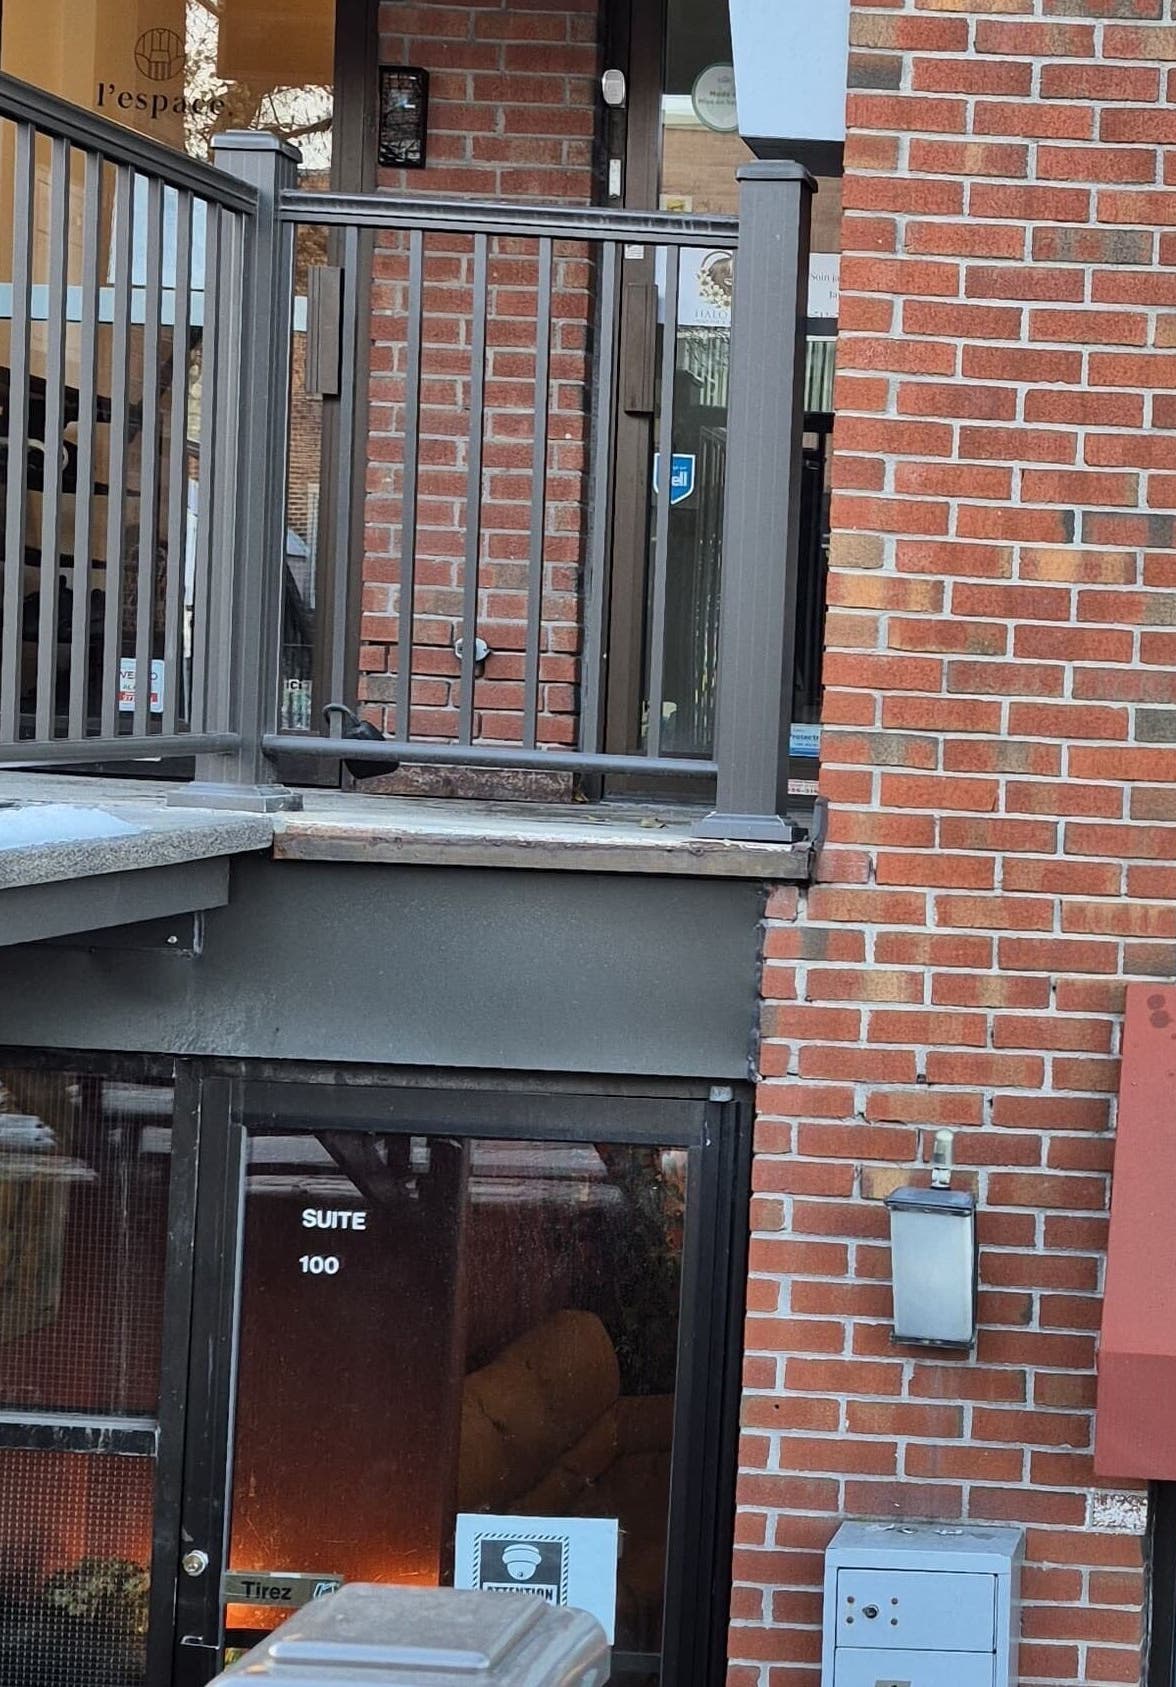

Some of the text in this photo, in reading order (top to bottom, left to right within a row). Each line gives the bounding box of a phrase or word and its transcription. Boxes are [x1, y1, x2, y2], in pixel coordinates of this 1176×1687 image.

[302, 1208, 367, 1230] SUITE
[298, 1255, 340, 1275] 100
[241, 1581, 292, 1600] Tirez
